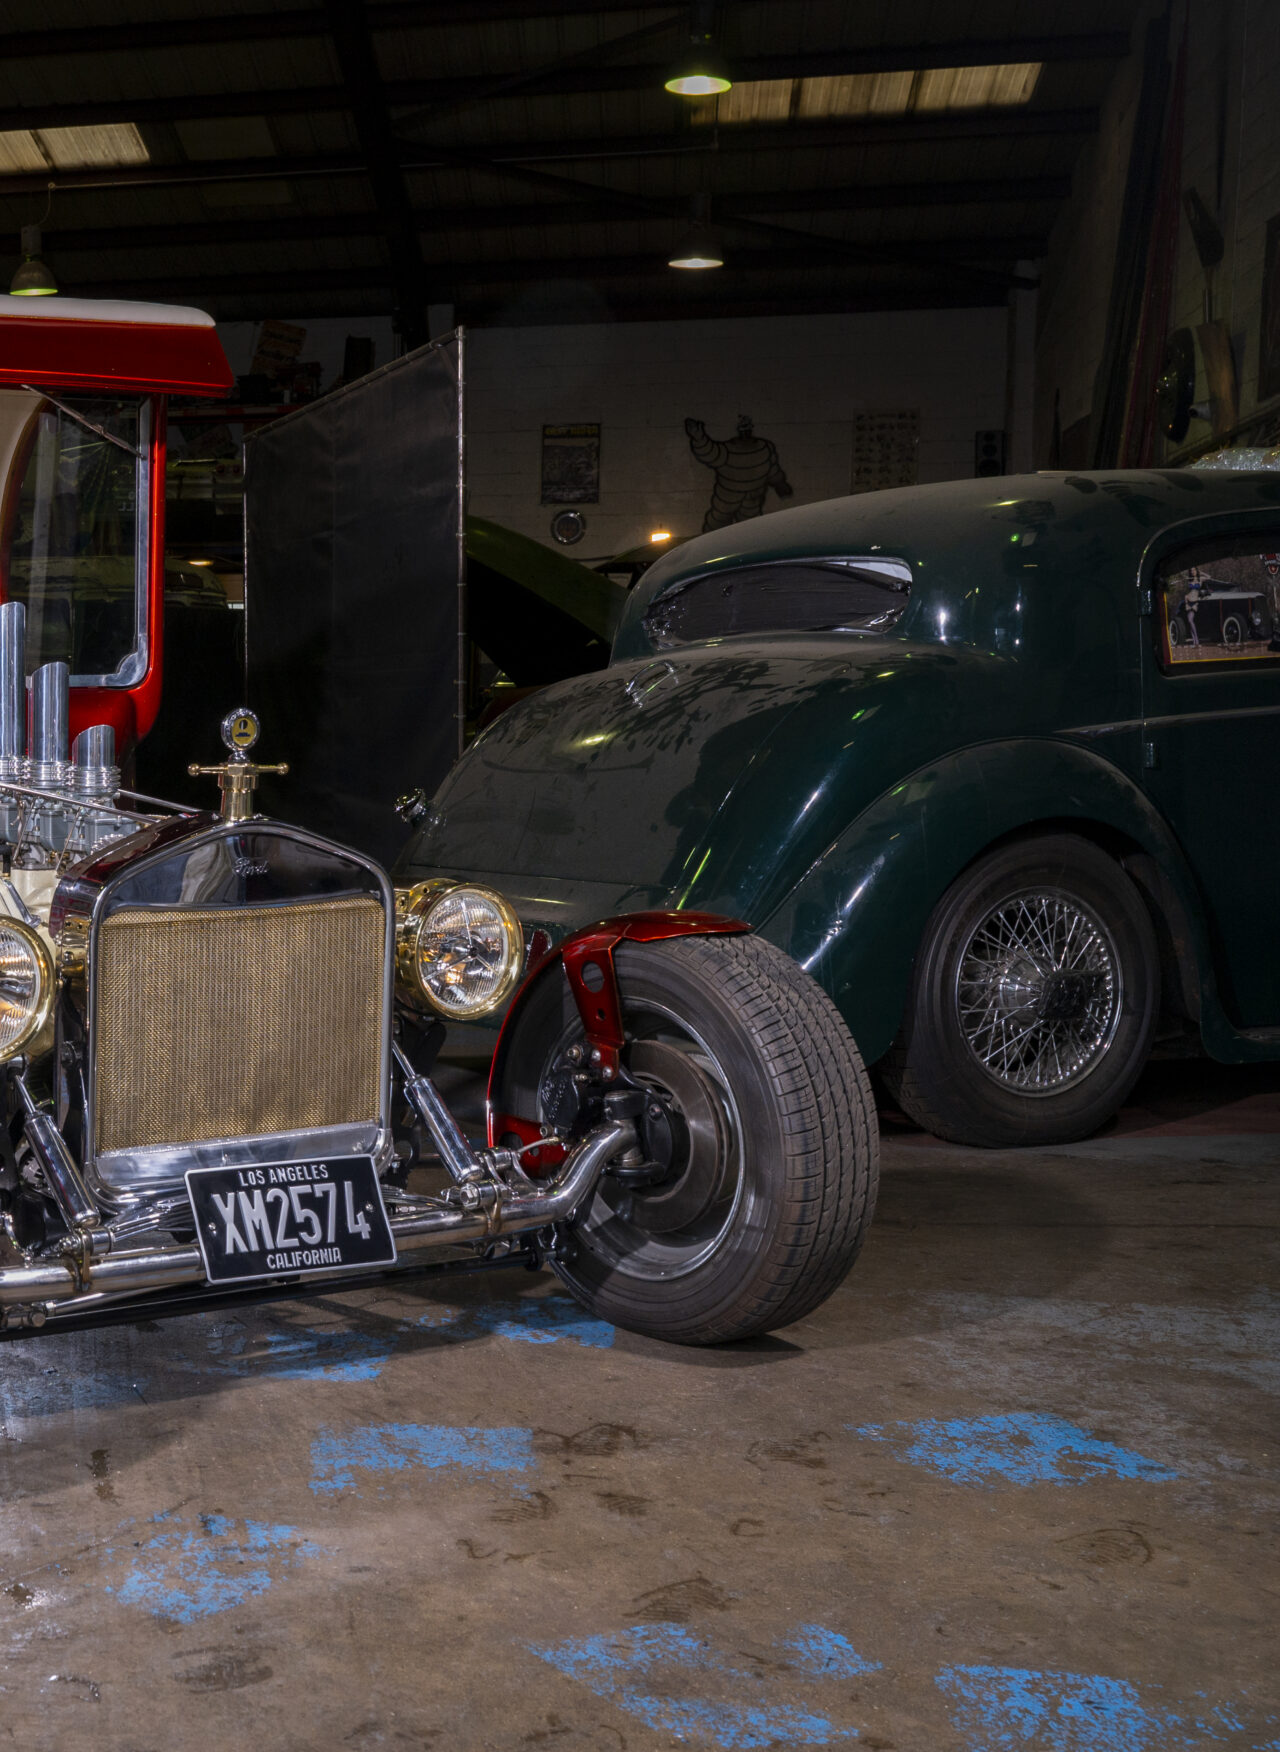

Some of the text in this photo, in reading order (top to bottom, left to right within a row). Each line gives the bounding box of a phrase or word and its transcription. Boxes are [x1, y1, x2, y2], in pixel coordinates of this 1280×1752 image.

[237, 1164, 329, 1187] LOS ANGELES
[210, 1180, 372, 1255] XM2574
[266, 1247, 342, 1271] CALIFORNIA
